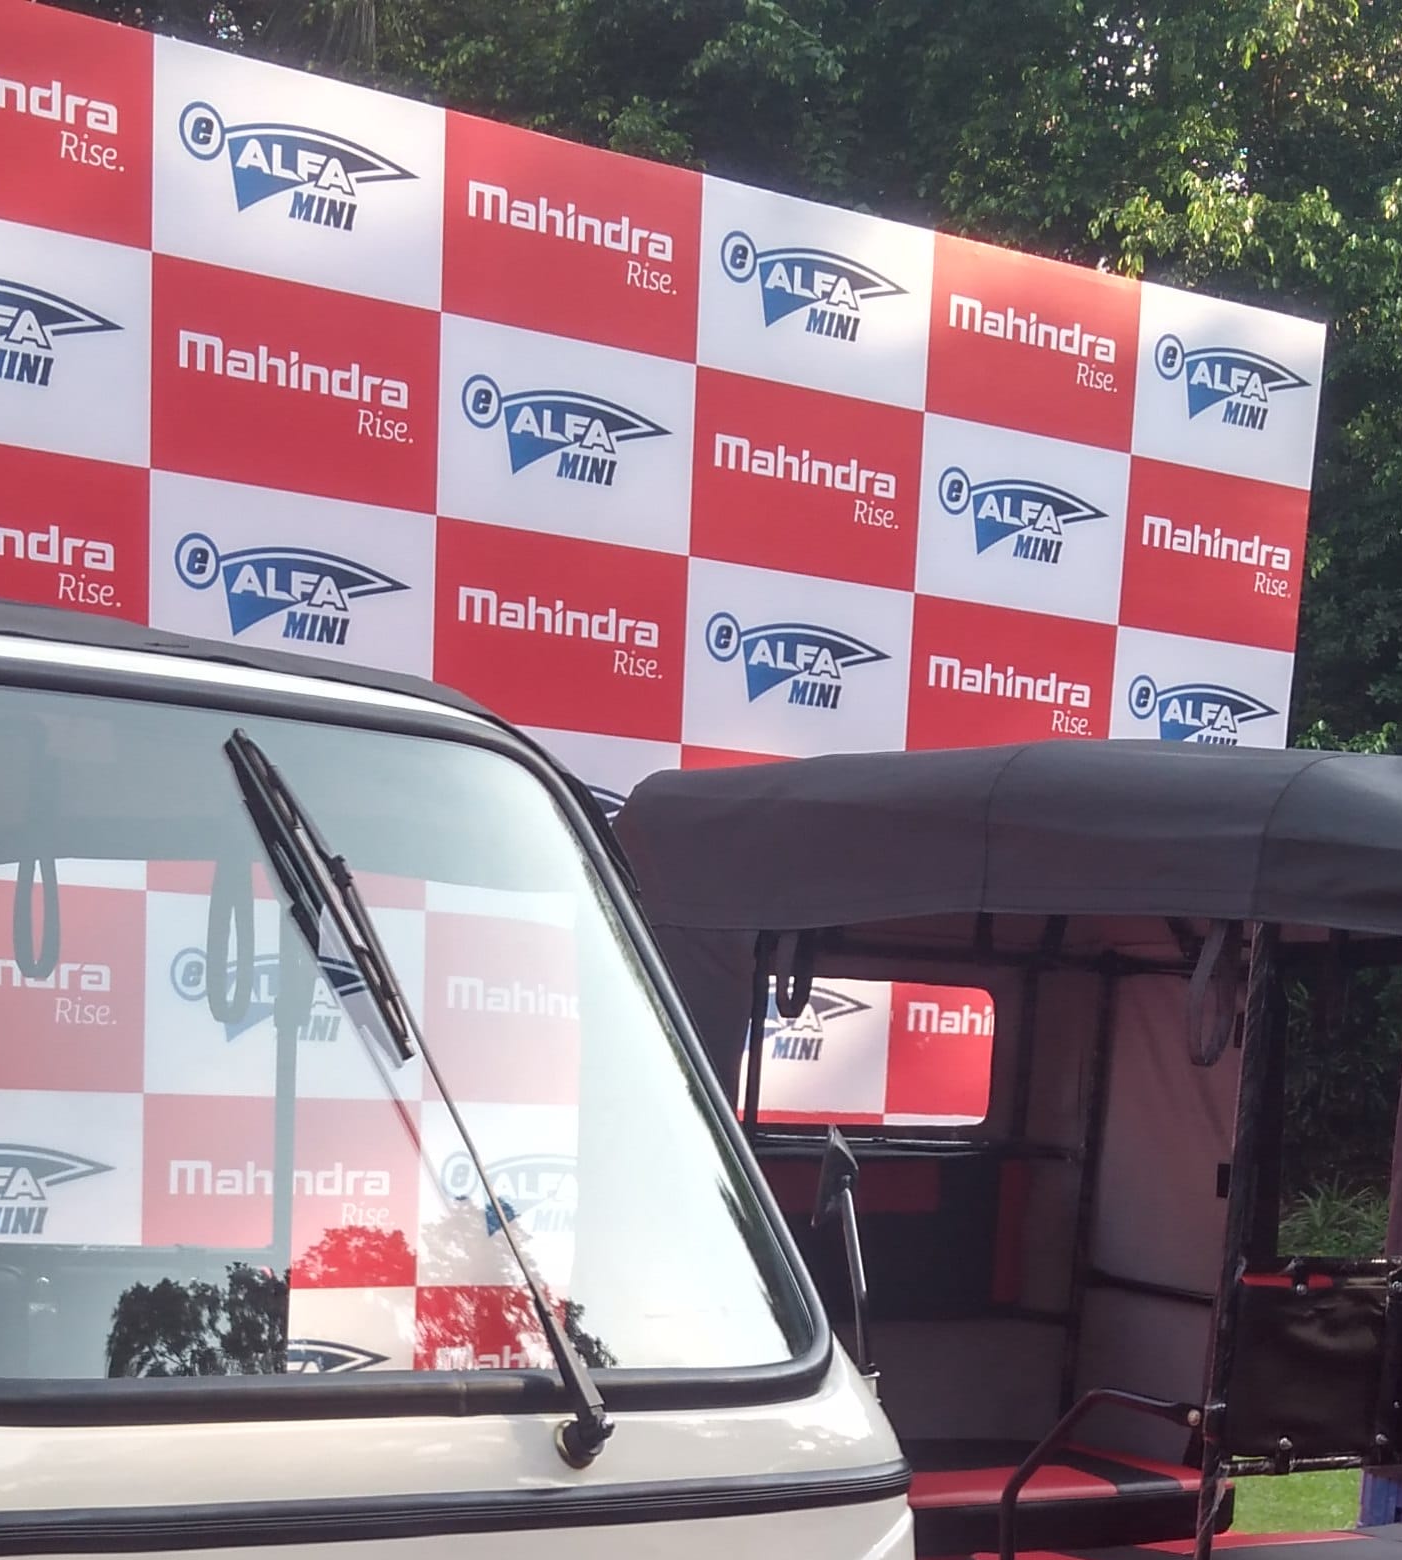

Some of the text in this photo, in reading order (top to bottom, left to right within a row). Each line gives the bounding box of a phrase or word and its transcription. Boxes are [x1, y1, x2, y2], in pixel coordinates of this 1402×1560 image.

[60, 130, 124, 173] Rise.
[235, 138, 355, 197] ALFA
[289, 191, 357, 231] MINI
[468, 180, 673, 262] Mahindra
[626, 261, 678, 297] Rise.
[764, 264, 859, 312] ALFA
[805, 308, 861, 342] MINI
[950, 293, 1116, 363] Mahindra
[178, 330, 409, 410] Mahindra
[1076, 362, 1118, 394] Rise.
[1189, 360, 1267, 403] ALFA
[358, 409, 414, 445] Rise.
[510, 406, 616, 454] ALFA
[1221, 399, 1268, 432] MINI
[556, 450, 618, 487] MINI
[714, 433, 897, 500] Mahindra
[854, 498, 899, 530] Rise.
[977, 493, 1063, 537] ALFA
[1012, 533, 1064, 565] MINI
[1142, 514, 1291, 571] Mahindra
[58, 571, 122, 609] Rise.
[229, 568, 348, 611] ALFA
[1254, 570, 1291, 600] Rise.
[282, 609, 349, 646] MINI
[457, 587, 659, 649] Mahindra
[613, 648, 664, 681] Rise.
[748, 639, 840, 680] ALFA
[787, 677, 841, 710] MINI
[929, 655, 1091, 708] Mahindra
[1051, 707, 1092, 736] Rise.
[1161, 700, 1237, 733] ALFA
[55, 997, 117, 1024] Rise.
[772, 1037, 823, 1061] MINI
[169, 1160, 390, 1196] Mahndra
[341, 1201, 396, 1226] Rise.
